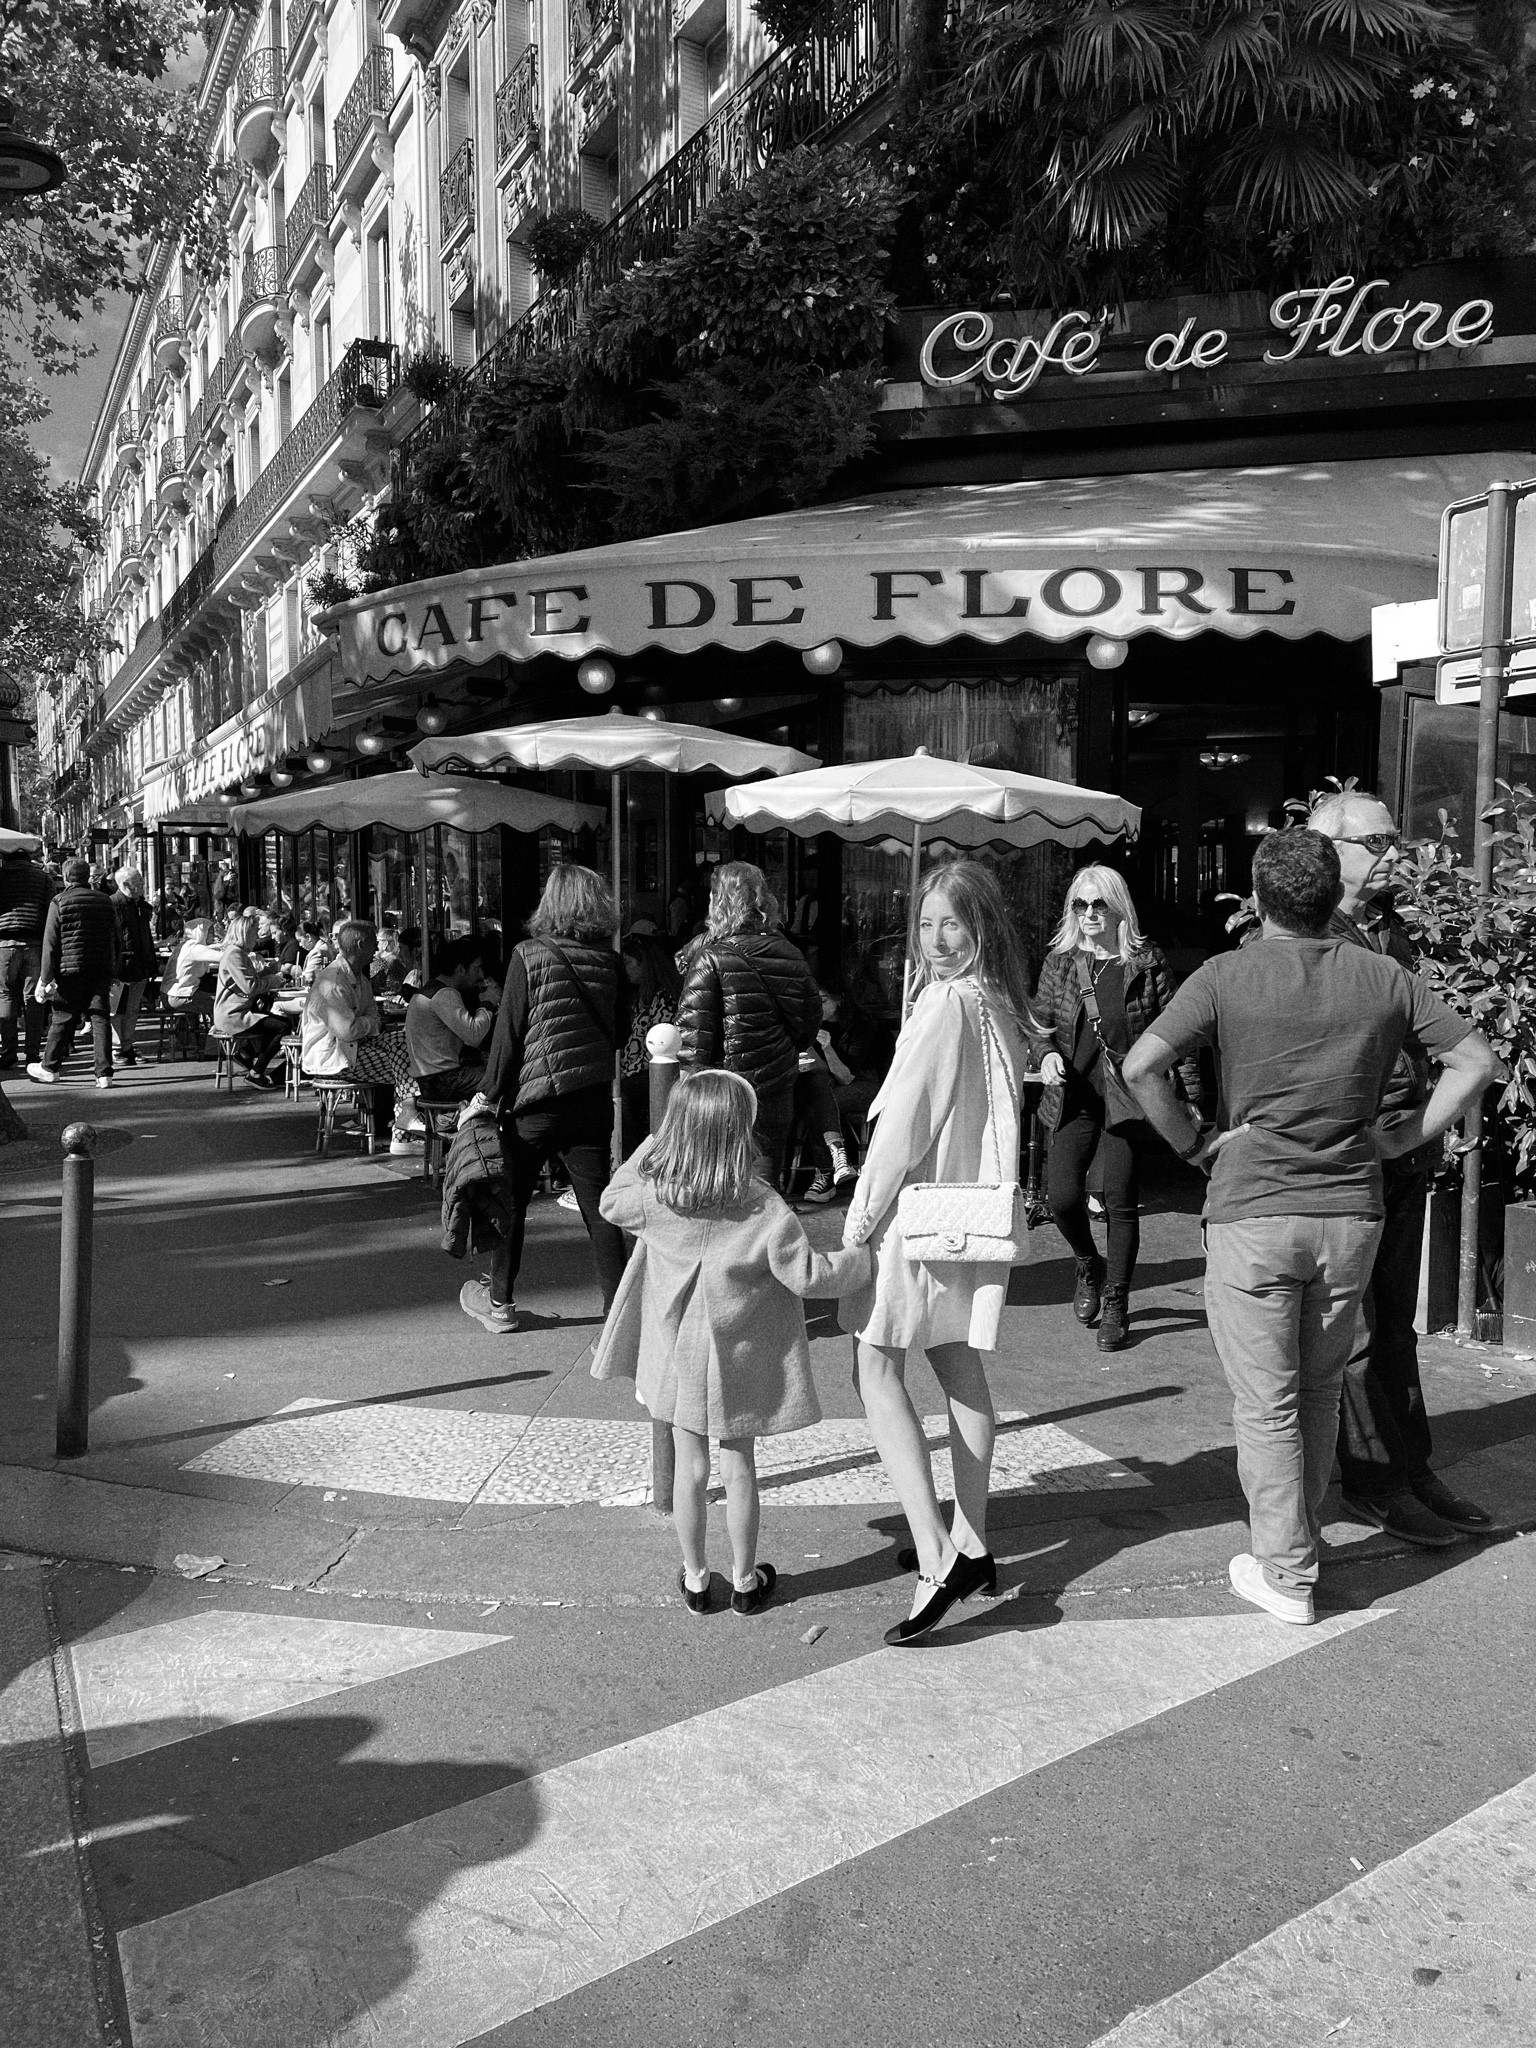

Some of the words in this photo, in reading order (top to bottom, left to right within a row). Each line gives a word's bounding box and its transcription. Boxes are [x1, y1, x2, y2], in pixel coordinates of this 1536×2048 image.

[918, 306, 1107, 400] Café
[1144, 316, 1230, 373] de
[1263, 275, 1495, 366] Flore
[376, 584, 593, 657] CAFE
[645, 575, 806, 630] DE
[870, 565, 1297, 622] FLORE
[491, 1311, 508, 1319] HOKA
